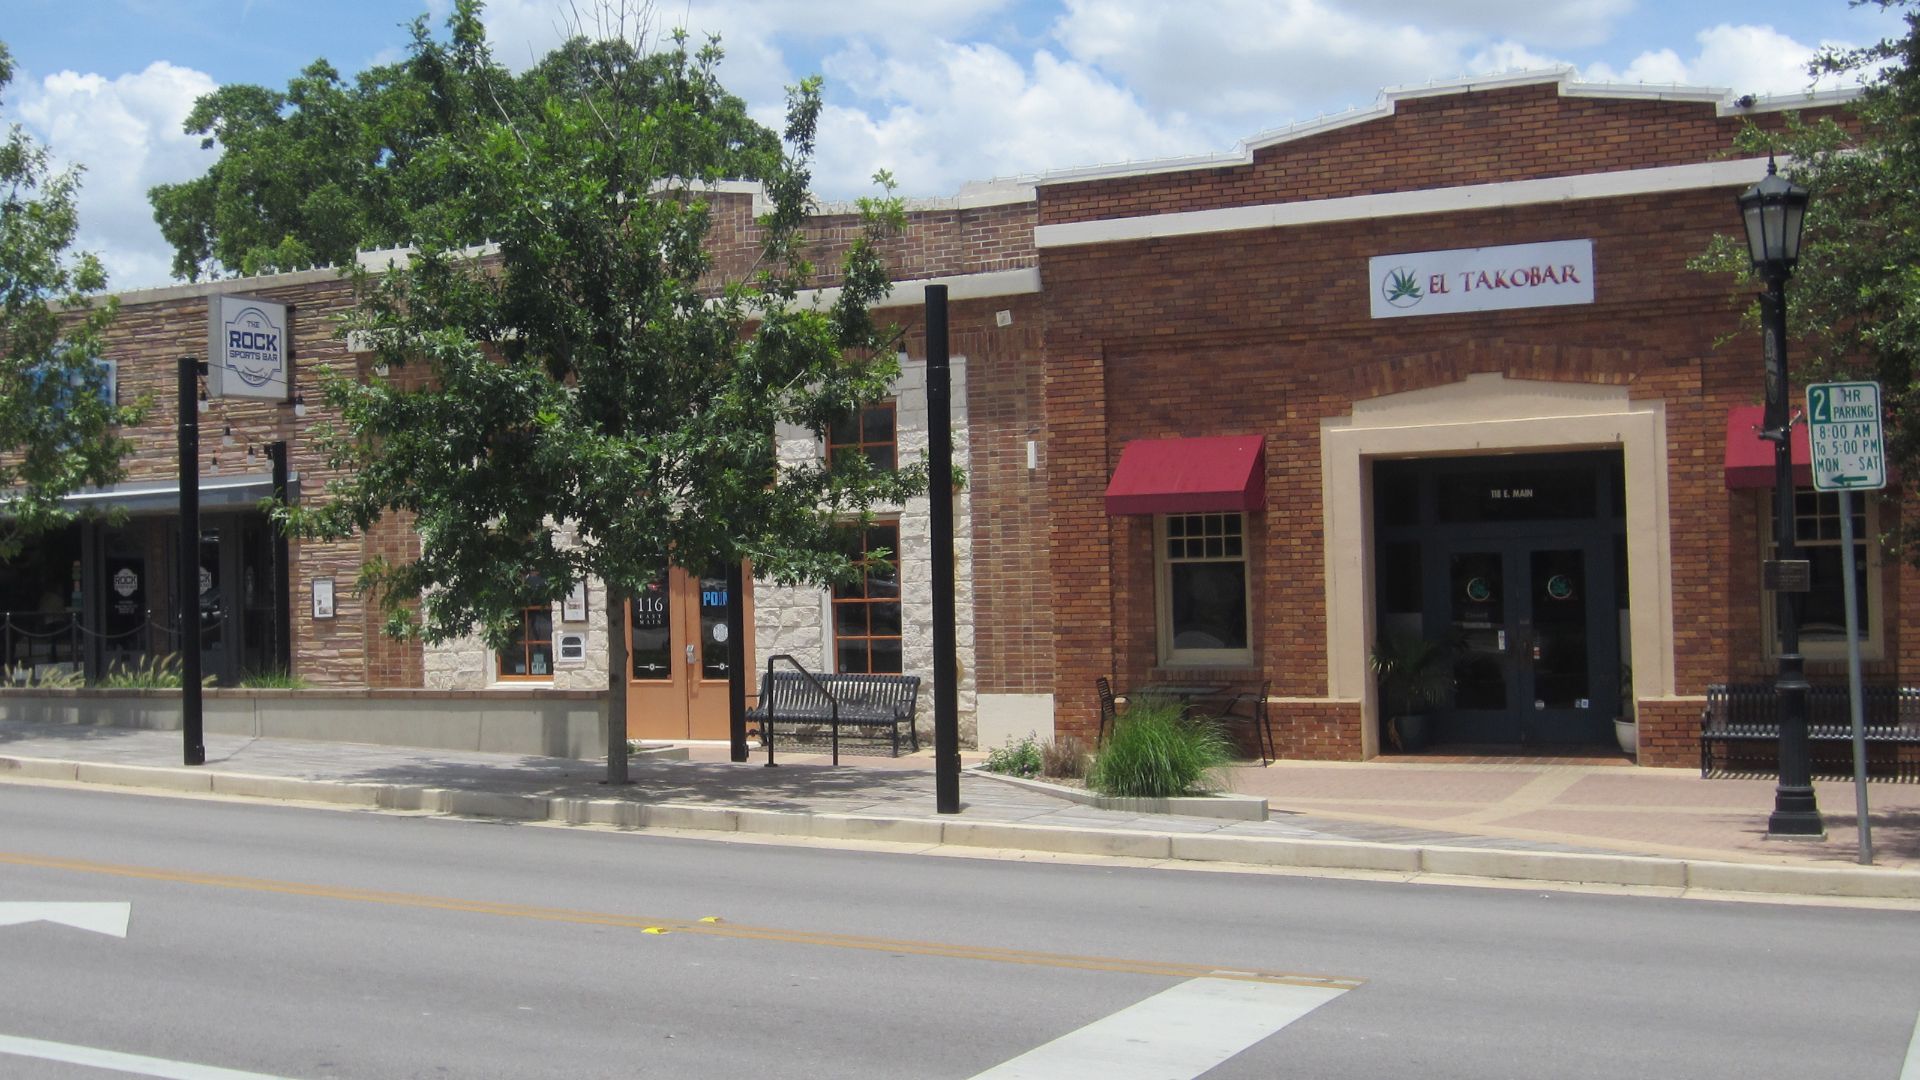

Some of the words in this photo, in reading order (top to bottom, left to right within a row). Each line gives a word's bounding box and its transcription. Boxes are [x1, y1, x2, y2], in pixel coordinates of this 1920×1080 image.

[1430, 274, 1450, 294] EL
[1460, 265, 1580, 292] TAKOBAR
[229, 331, 277, 351] ROCK
[230, 350, 260, 360] SPORTS
[262, 353, 278, 361] BAR
[1813, 390, 1826, 420] 2
[1843, 390, 1861, 402] HR
[1834, 405, 1873, 419] PARKING
[1820, 425, 1847, 439] 8:00
[1855, 424, 1870, 437] AM
[1833, 440, 1858, 455] 5:00
[1863, 440, 1878, 452] PM
[1859, 456, 1878, 470] SAT
[1513, 489, 1532, 497] MAIN
[638, 597, 663, 612] 116
[702, 591, 728, 606] POIN
